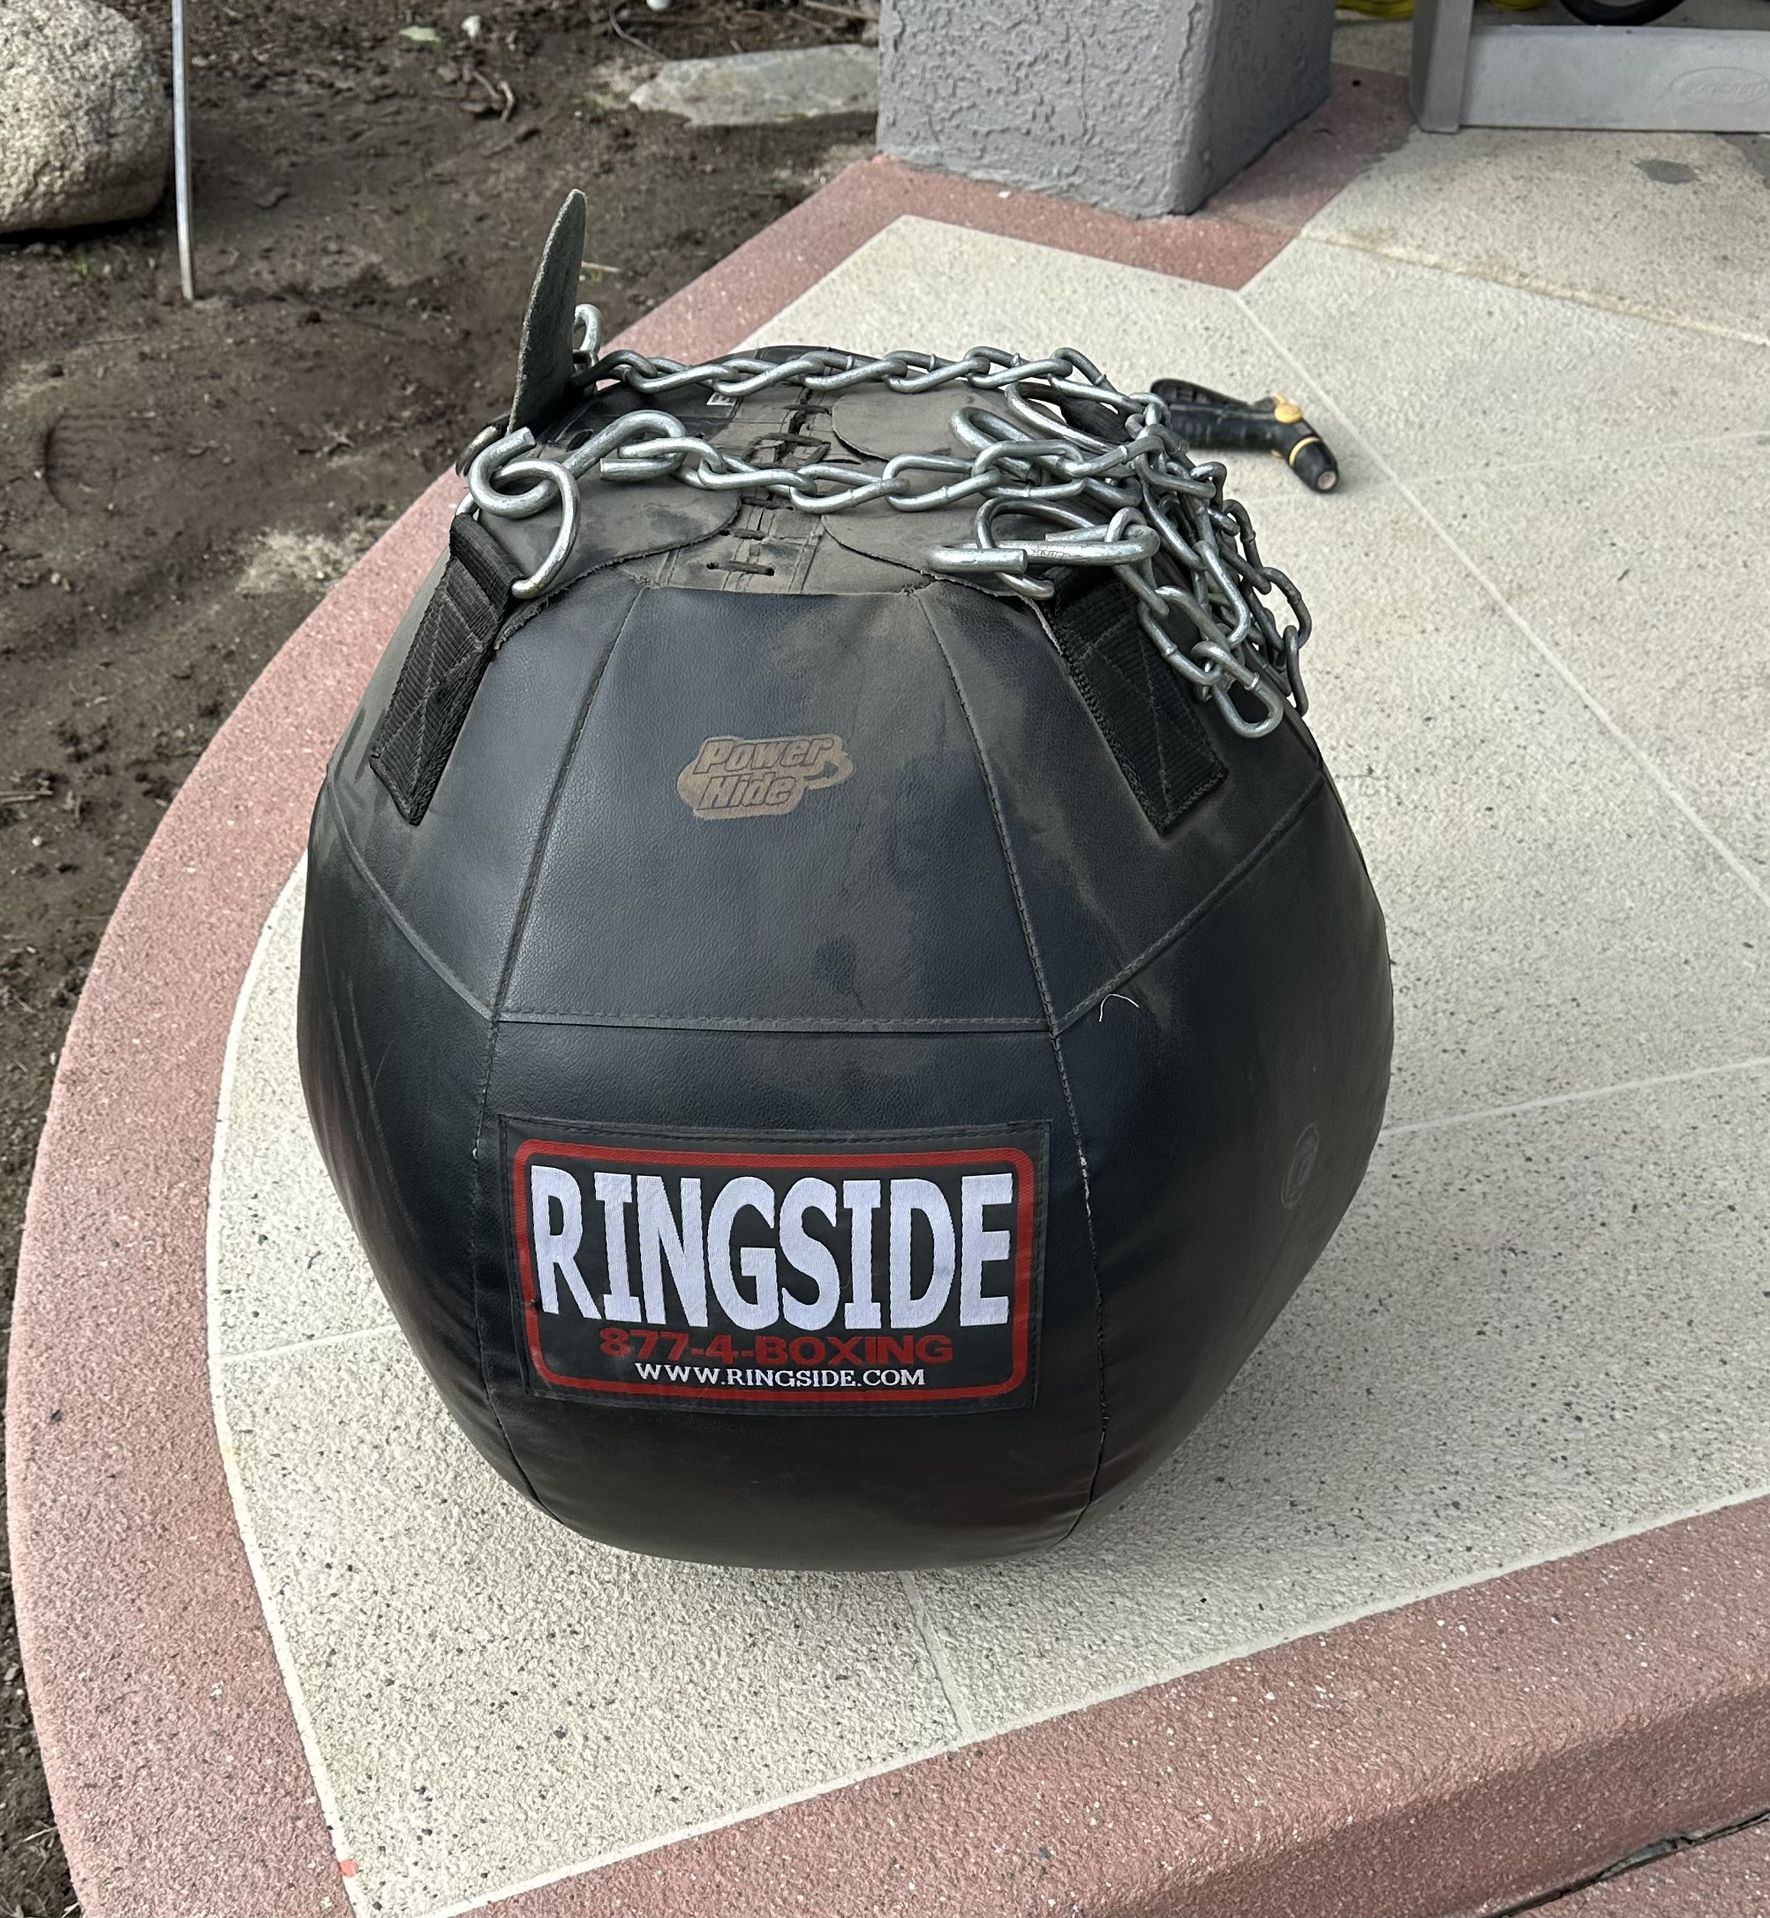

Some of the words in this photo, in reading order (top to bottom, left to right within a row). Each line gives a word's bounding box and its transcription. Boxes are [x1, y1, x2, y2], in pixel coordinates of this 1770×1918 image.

[693, 737, 834, 775] Power
[696, 771, 797, 810] Hide
[531, 1165, 1013, 1331] RINGSIDE
[600, 1327, 954, 1366] 877-4-BOXING
[635, 1362, 925, 1388] WWW.RINGSIDE.COM
